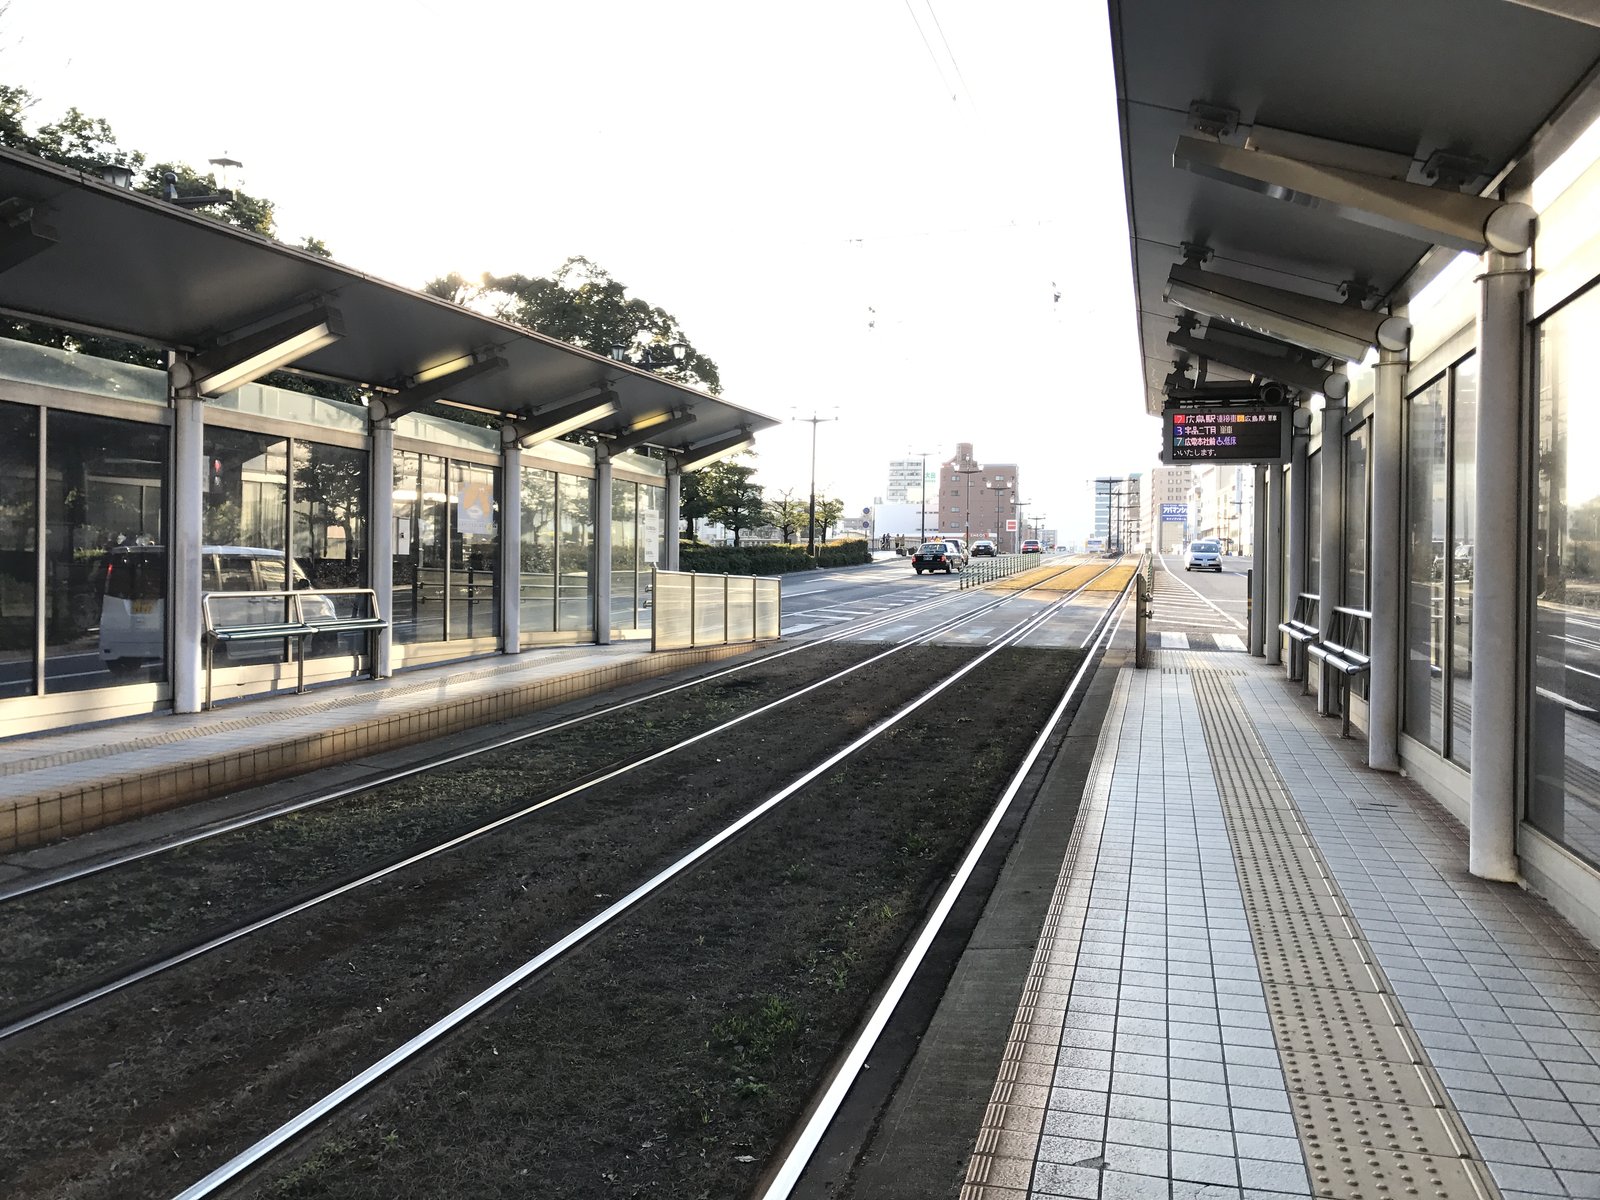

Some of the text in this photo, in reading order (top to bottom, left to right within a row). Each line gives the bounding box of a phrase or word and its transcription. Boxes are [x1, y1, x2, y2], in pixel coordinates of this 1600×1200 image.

[1186, 414, 1216, 423] 広島駅
[1176, 426, 1183, 436] 3
[1185, 425, 1216, 435] 宇品二丁目
[1176, 437, 1183, 446] 7
[1185, 437, 1216, 446] 広電本社前
[1173, 449, 1217, 457] いいたします。
[1163, 506, 1187, 514] アパマンシ
